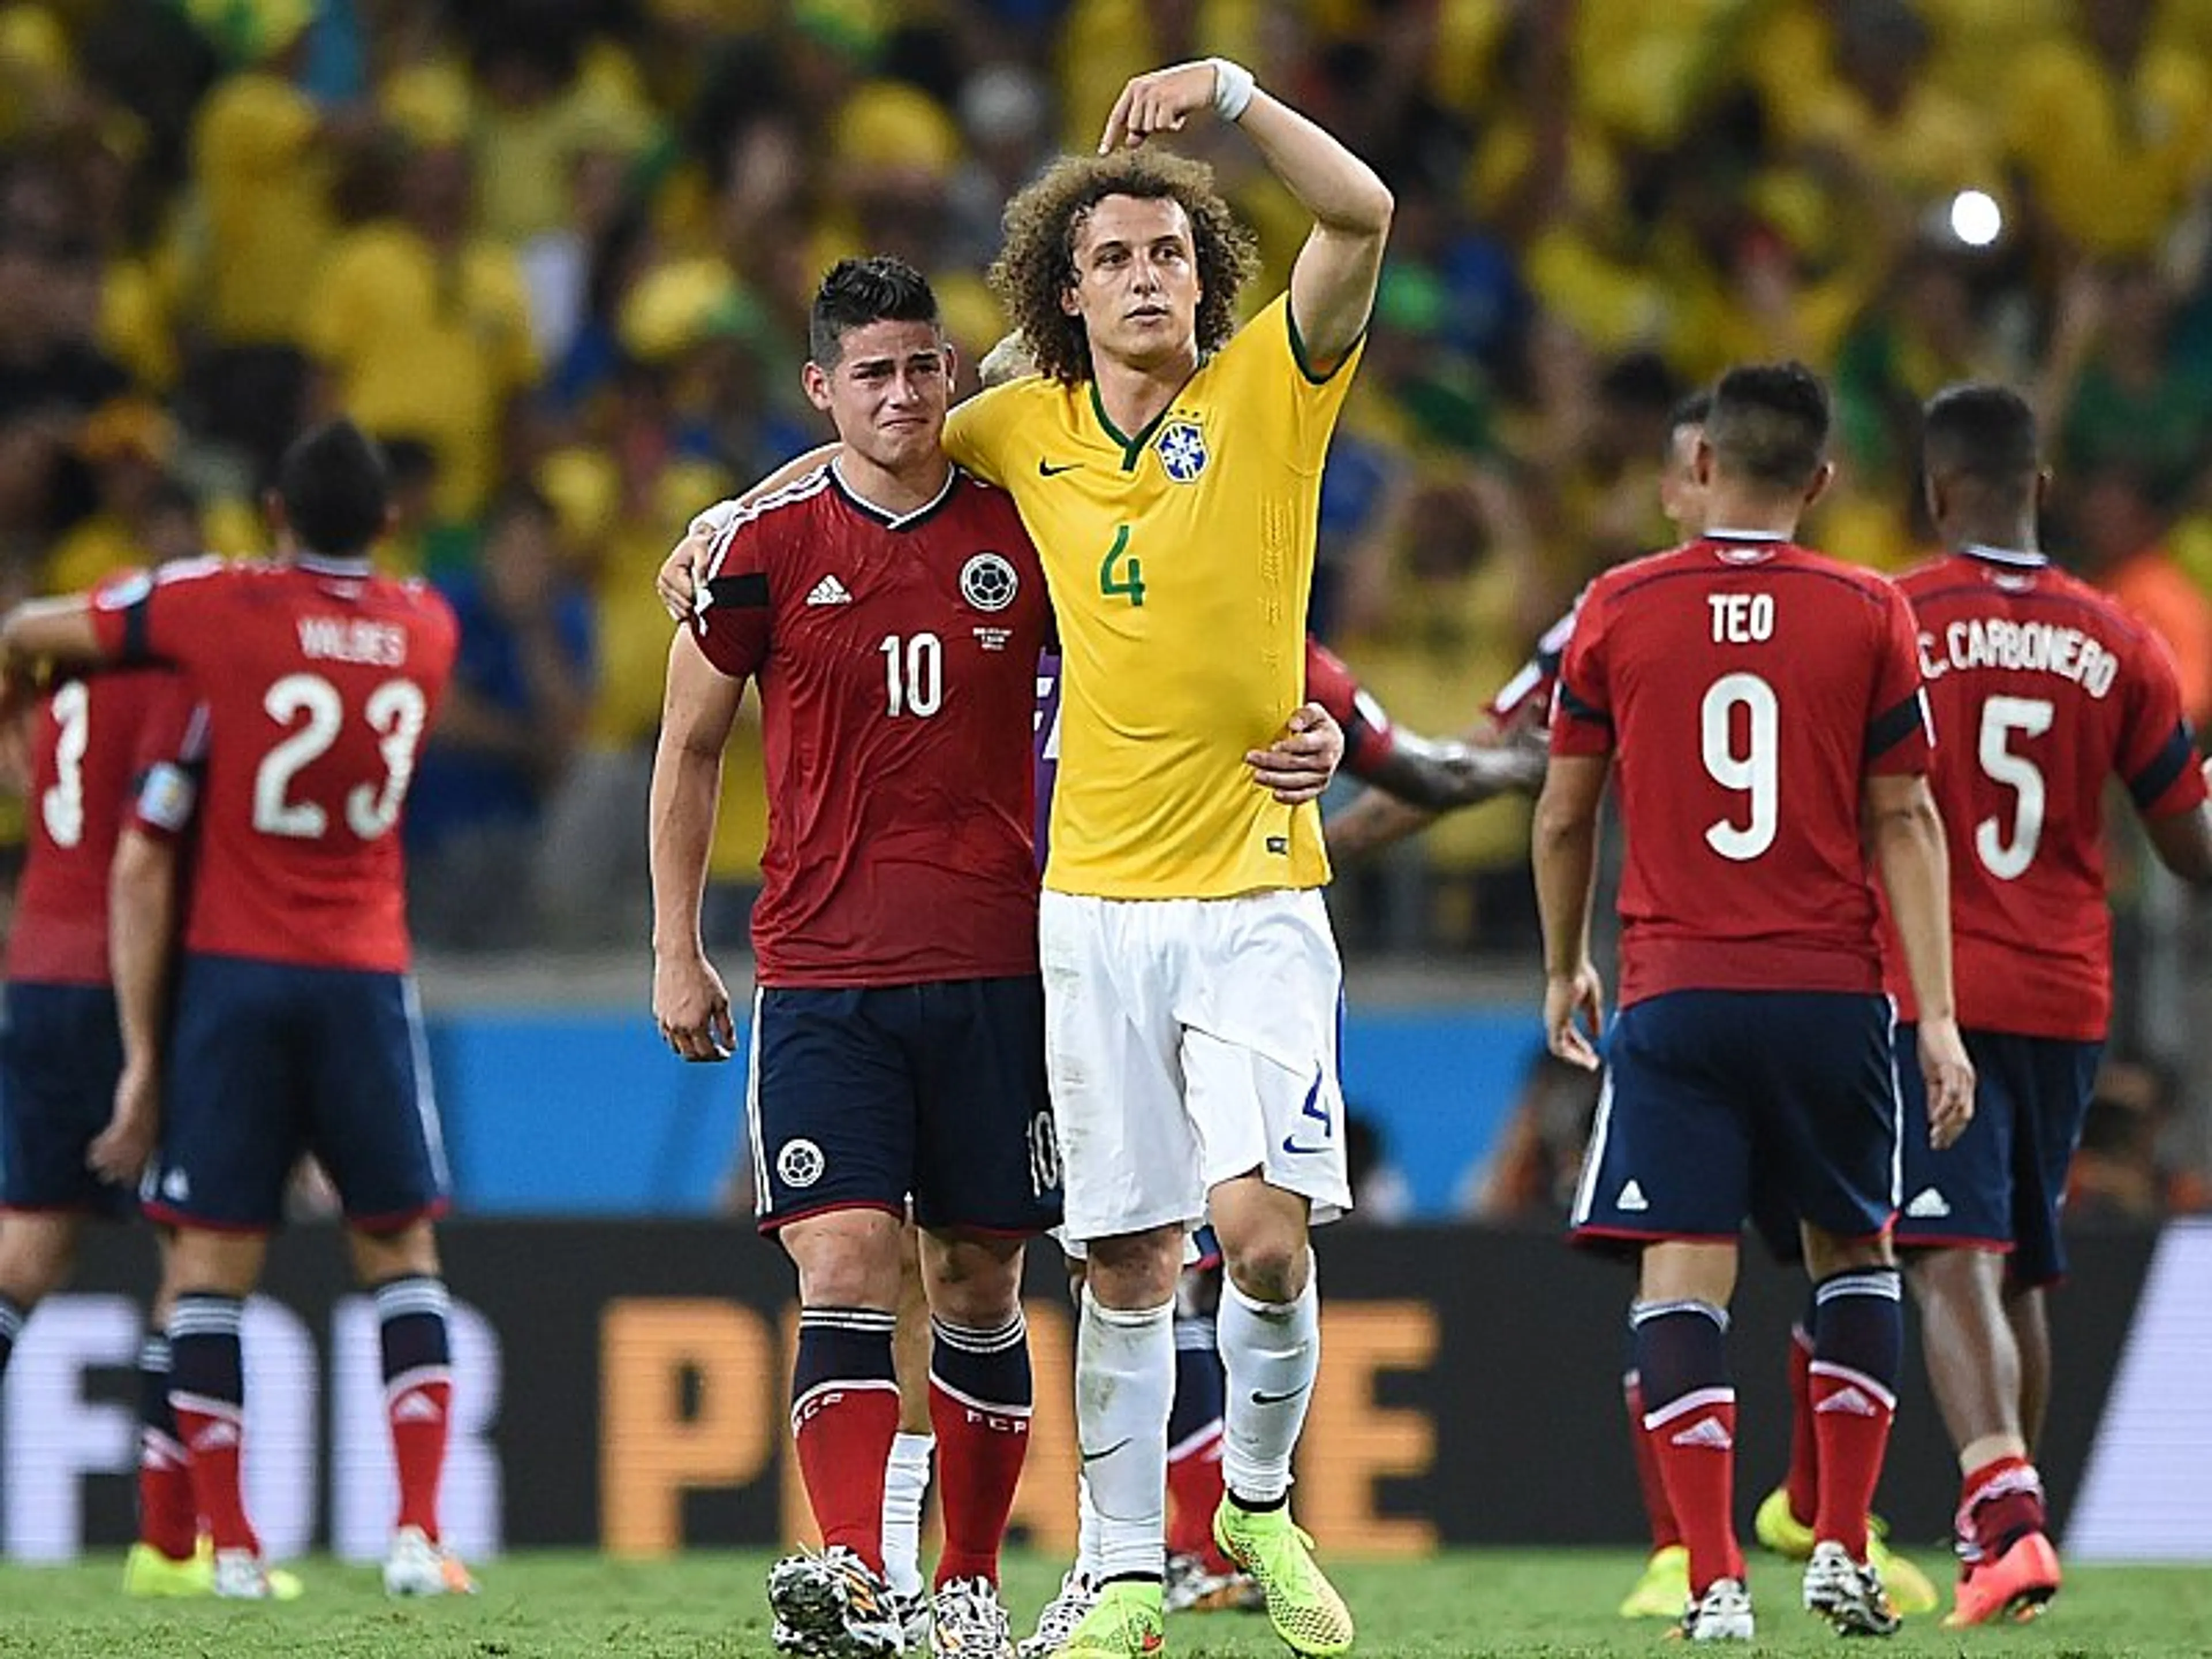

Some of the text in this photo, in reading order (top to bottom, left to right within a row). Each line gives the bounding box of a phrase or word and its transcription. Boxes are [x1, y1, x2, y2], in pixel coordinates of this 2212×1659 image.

[1101, 525, 1145, 607] 4
[1707, 593, 1774, 643] TEO
[879, 632, 941, 717] 10
[253, 673, 426, 839] 23
[1702, 672, 1778, 860] 9
[1976, 695, 2053, 880] 5
[1302, 1062, 1331, 1137] 4
